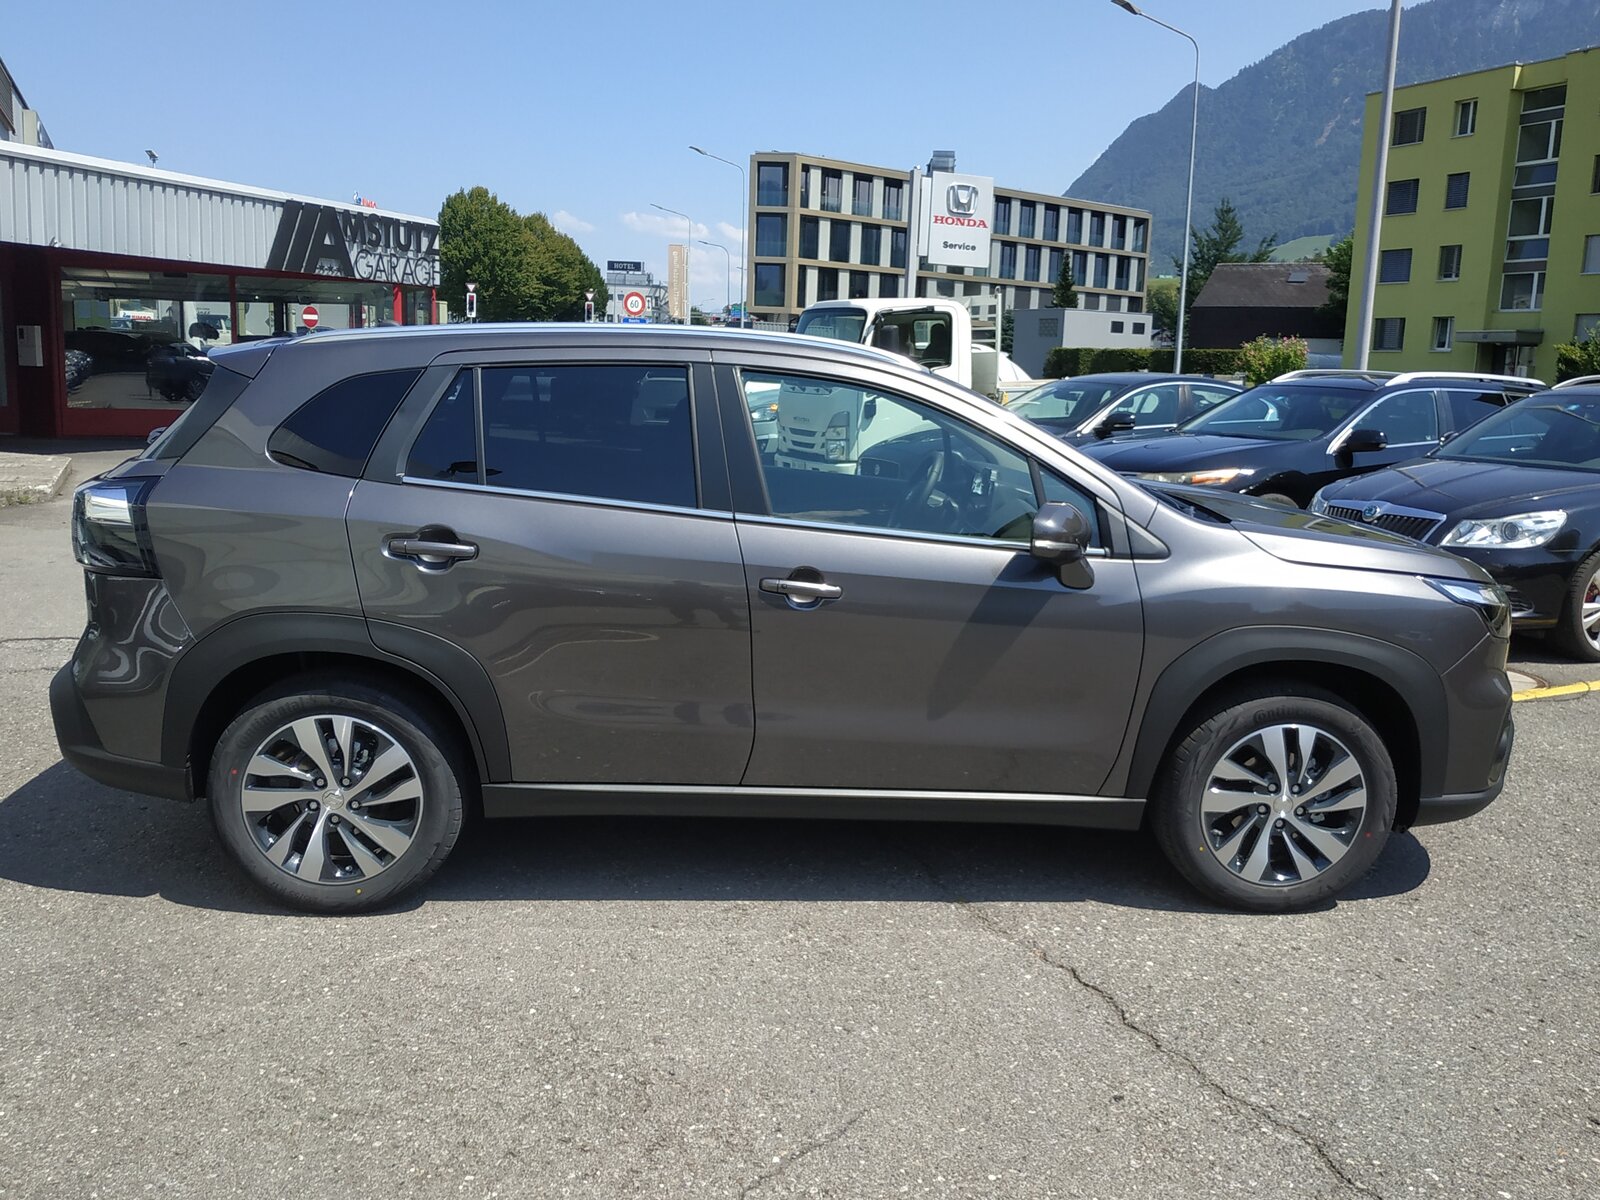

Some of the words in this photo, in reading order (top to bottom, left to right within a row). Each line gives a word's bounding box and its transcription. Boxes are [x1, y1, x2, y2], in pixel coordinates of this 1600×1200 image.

[933, 215, 987, 228] HONDA
[303, 206, 440, 278] AMSTUTZ
[942, 241, 976, 250] Service
[355, 249, 440, 287] GARAGE
[630, 300, 639, 308] 60
